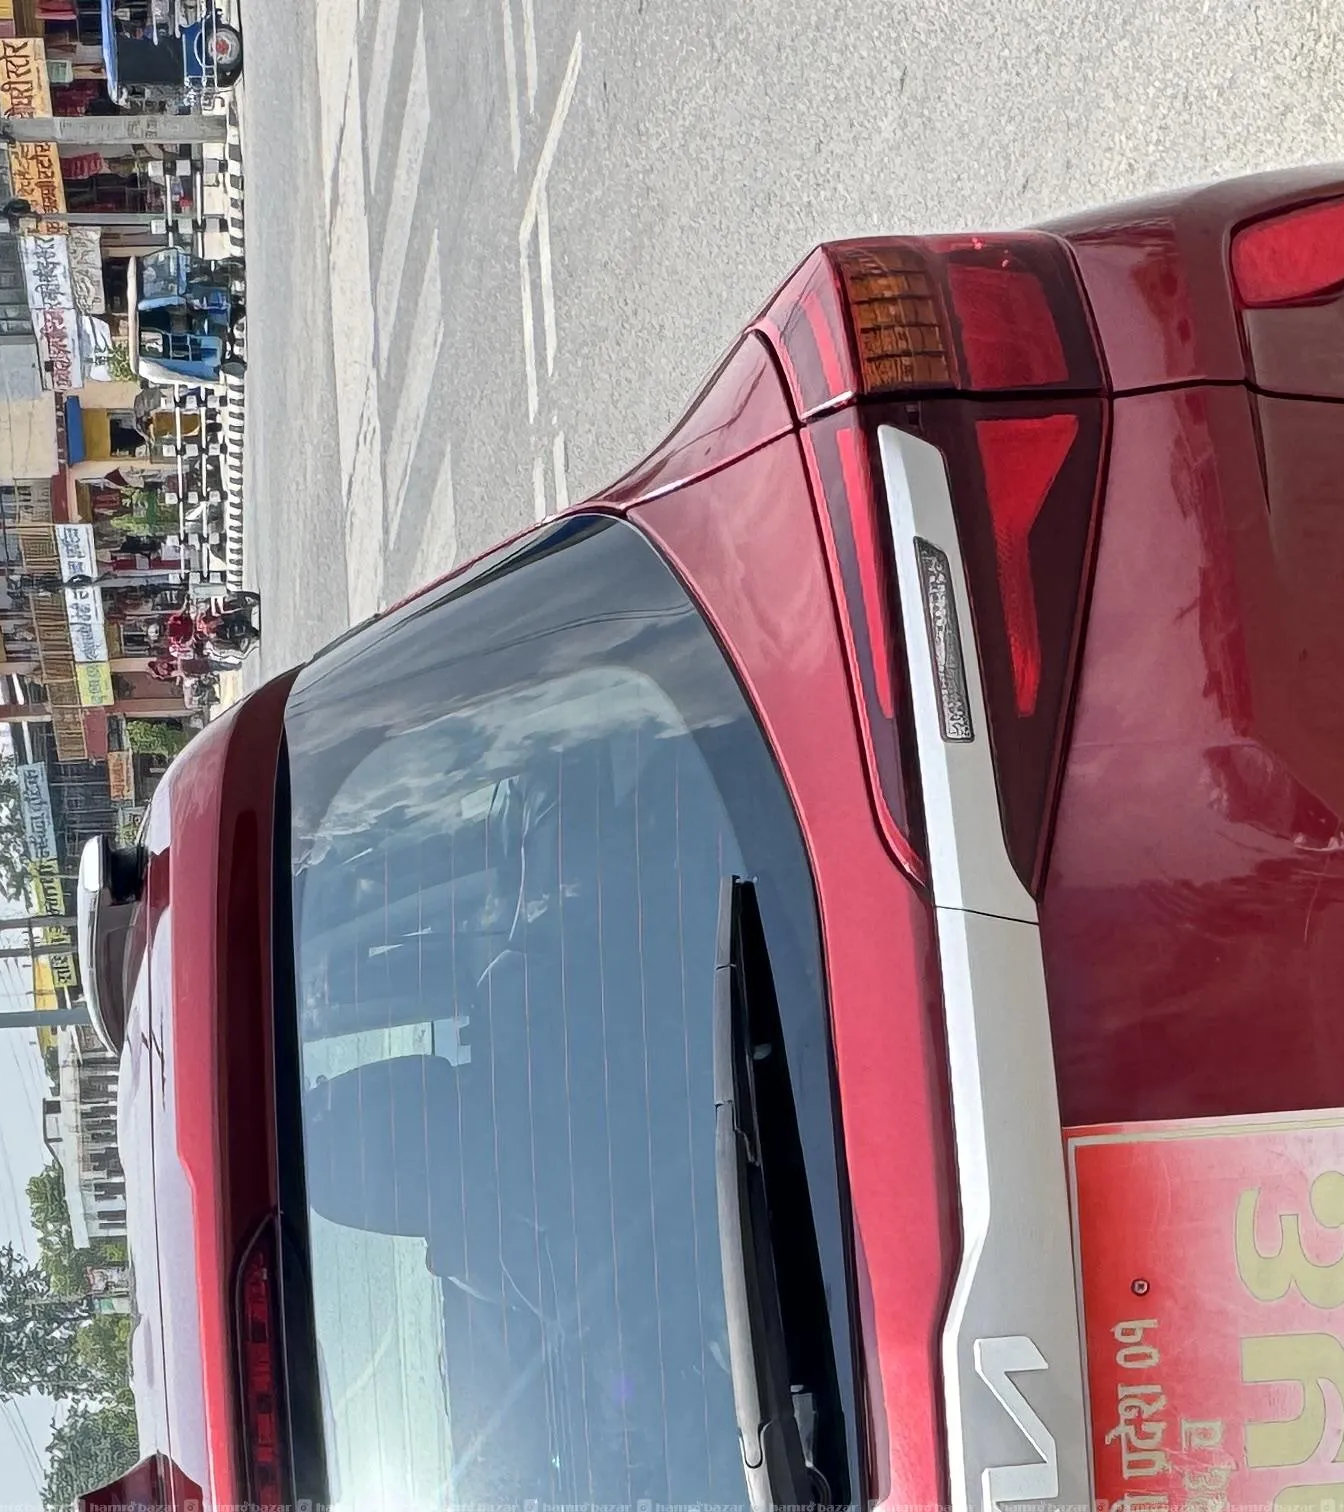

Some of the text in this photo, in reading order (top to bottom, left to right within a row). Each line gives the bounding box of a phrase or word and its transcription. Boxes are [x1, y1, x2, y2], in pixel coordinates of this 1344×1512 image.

[1110, 1318, 1159, 1369] ०१
[1105, 1383, 1172, 1480] प्रदेश
[1179, 1417, 1223, 1452] च
